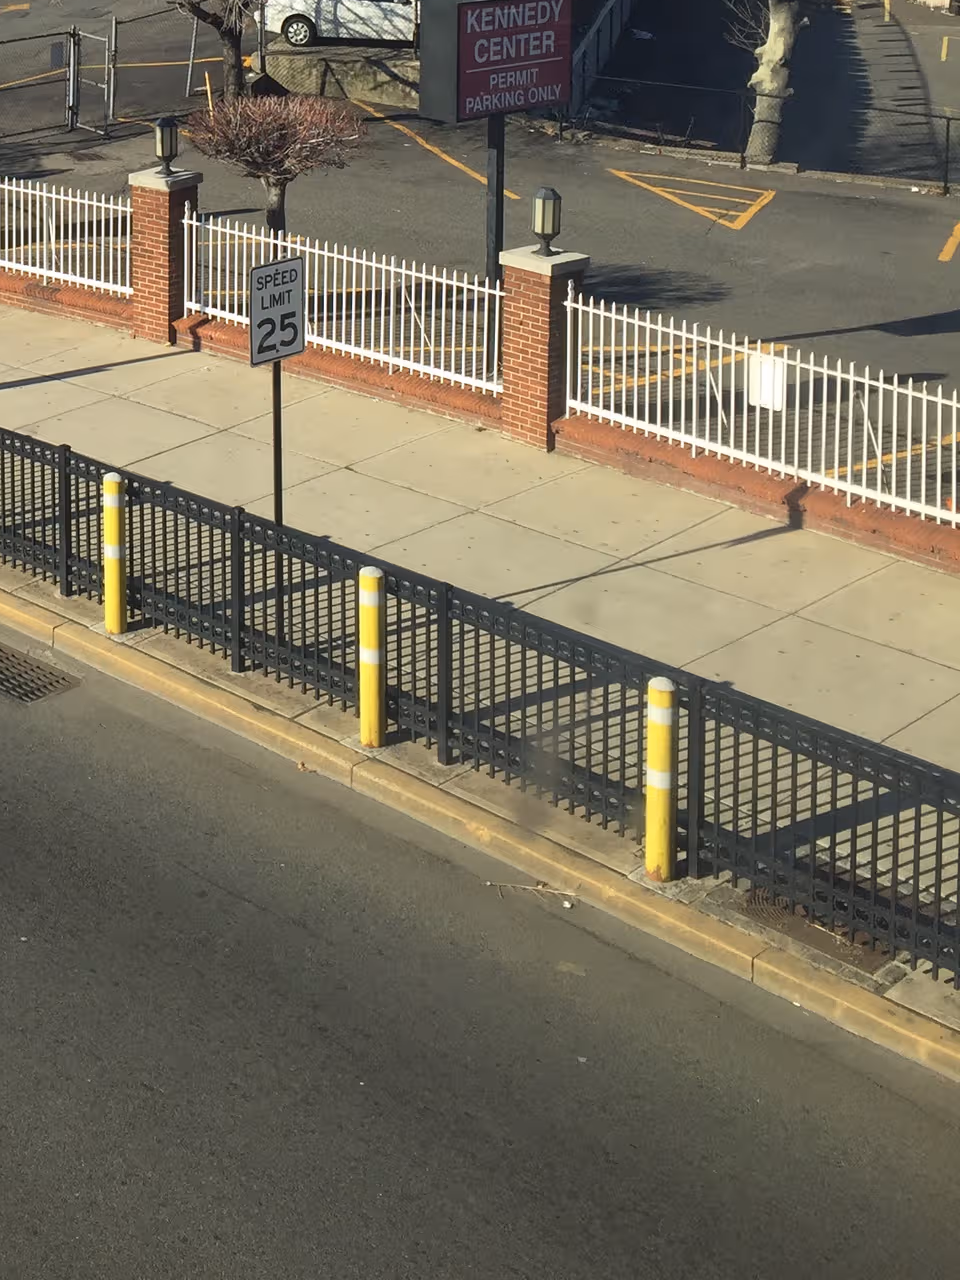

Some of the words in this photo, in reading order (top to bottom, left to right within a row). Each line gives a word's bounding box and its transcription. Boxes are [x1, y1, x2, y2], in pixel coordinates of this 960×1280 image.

[466, 0, 564, 33] KENNEDY
[474, 30, 555, 64] CENTER
[489, 68, 539, 90] PERMIT
[465, 91, 525, 114] PARKING
[528, 84, 562, 103] ONLY
[256, 268, 298, 291] SPEED
[261, 289, 293, 311] LIMIT
[256, 311, 298, 355] 25
